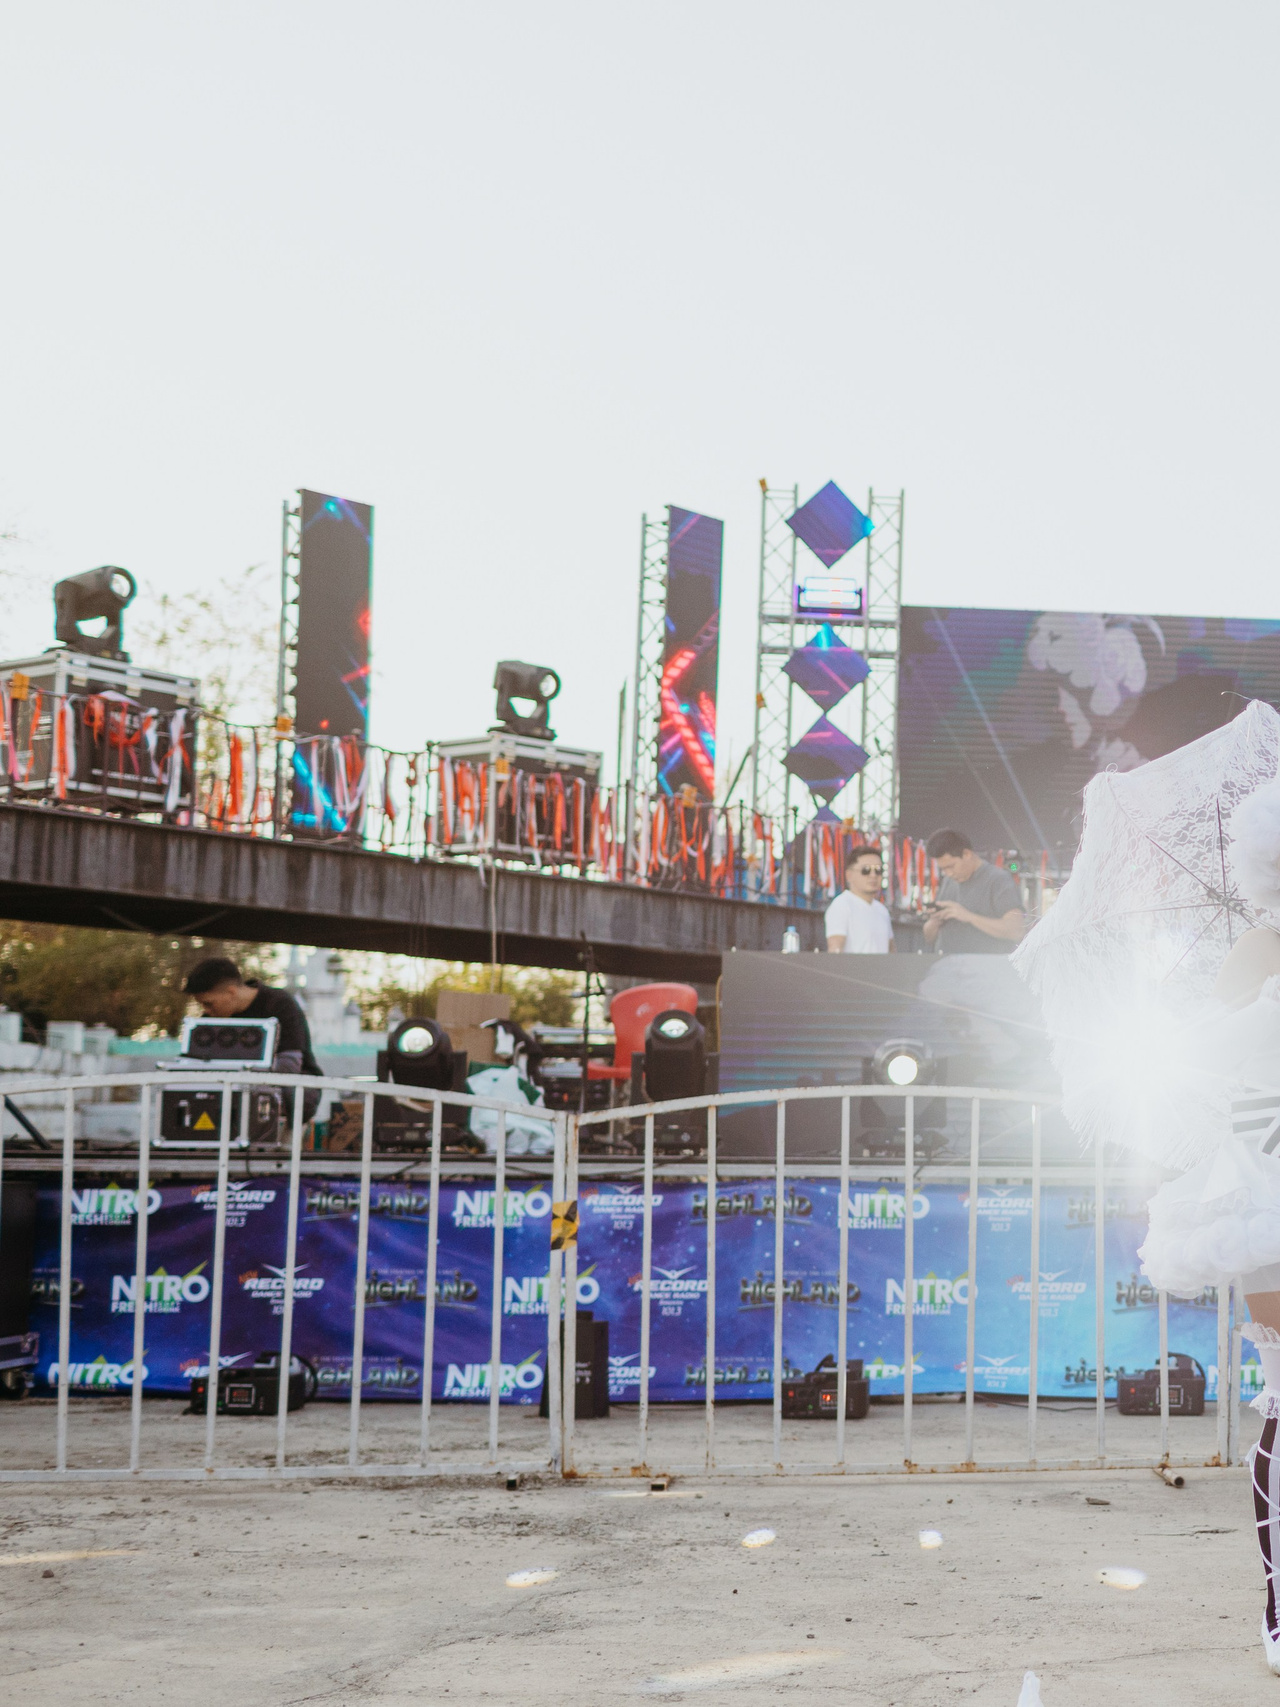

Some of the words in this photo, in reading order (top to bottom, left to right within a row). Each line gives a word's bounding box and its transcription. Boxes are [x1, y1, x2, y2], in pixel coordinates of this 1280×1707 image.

[71, 1188, 162, 1215] NITRO
[838, 1192, 929, 1219] NITRO
[112, 1274, 210, 1303] NTRO
[504, 1276, 600, 1304] NITO
